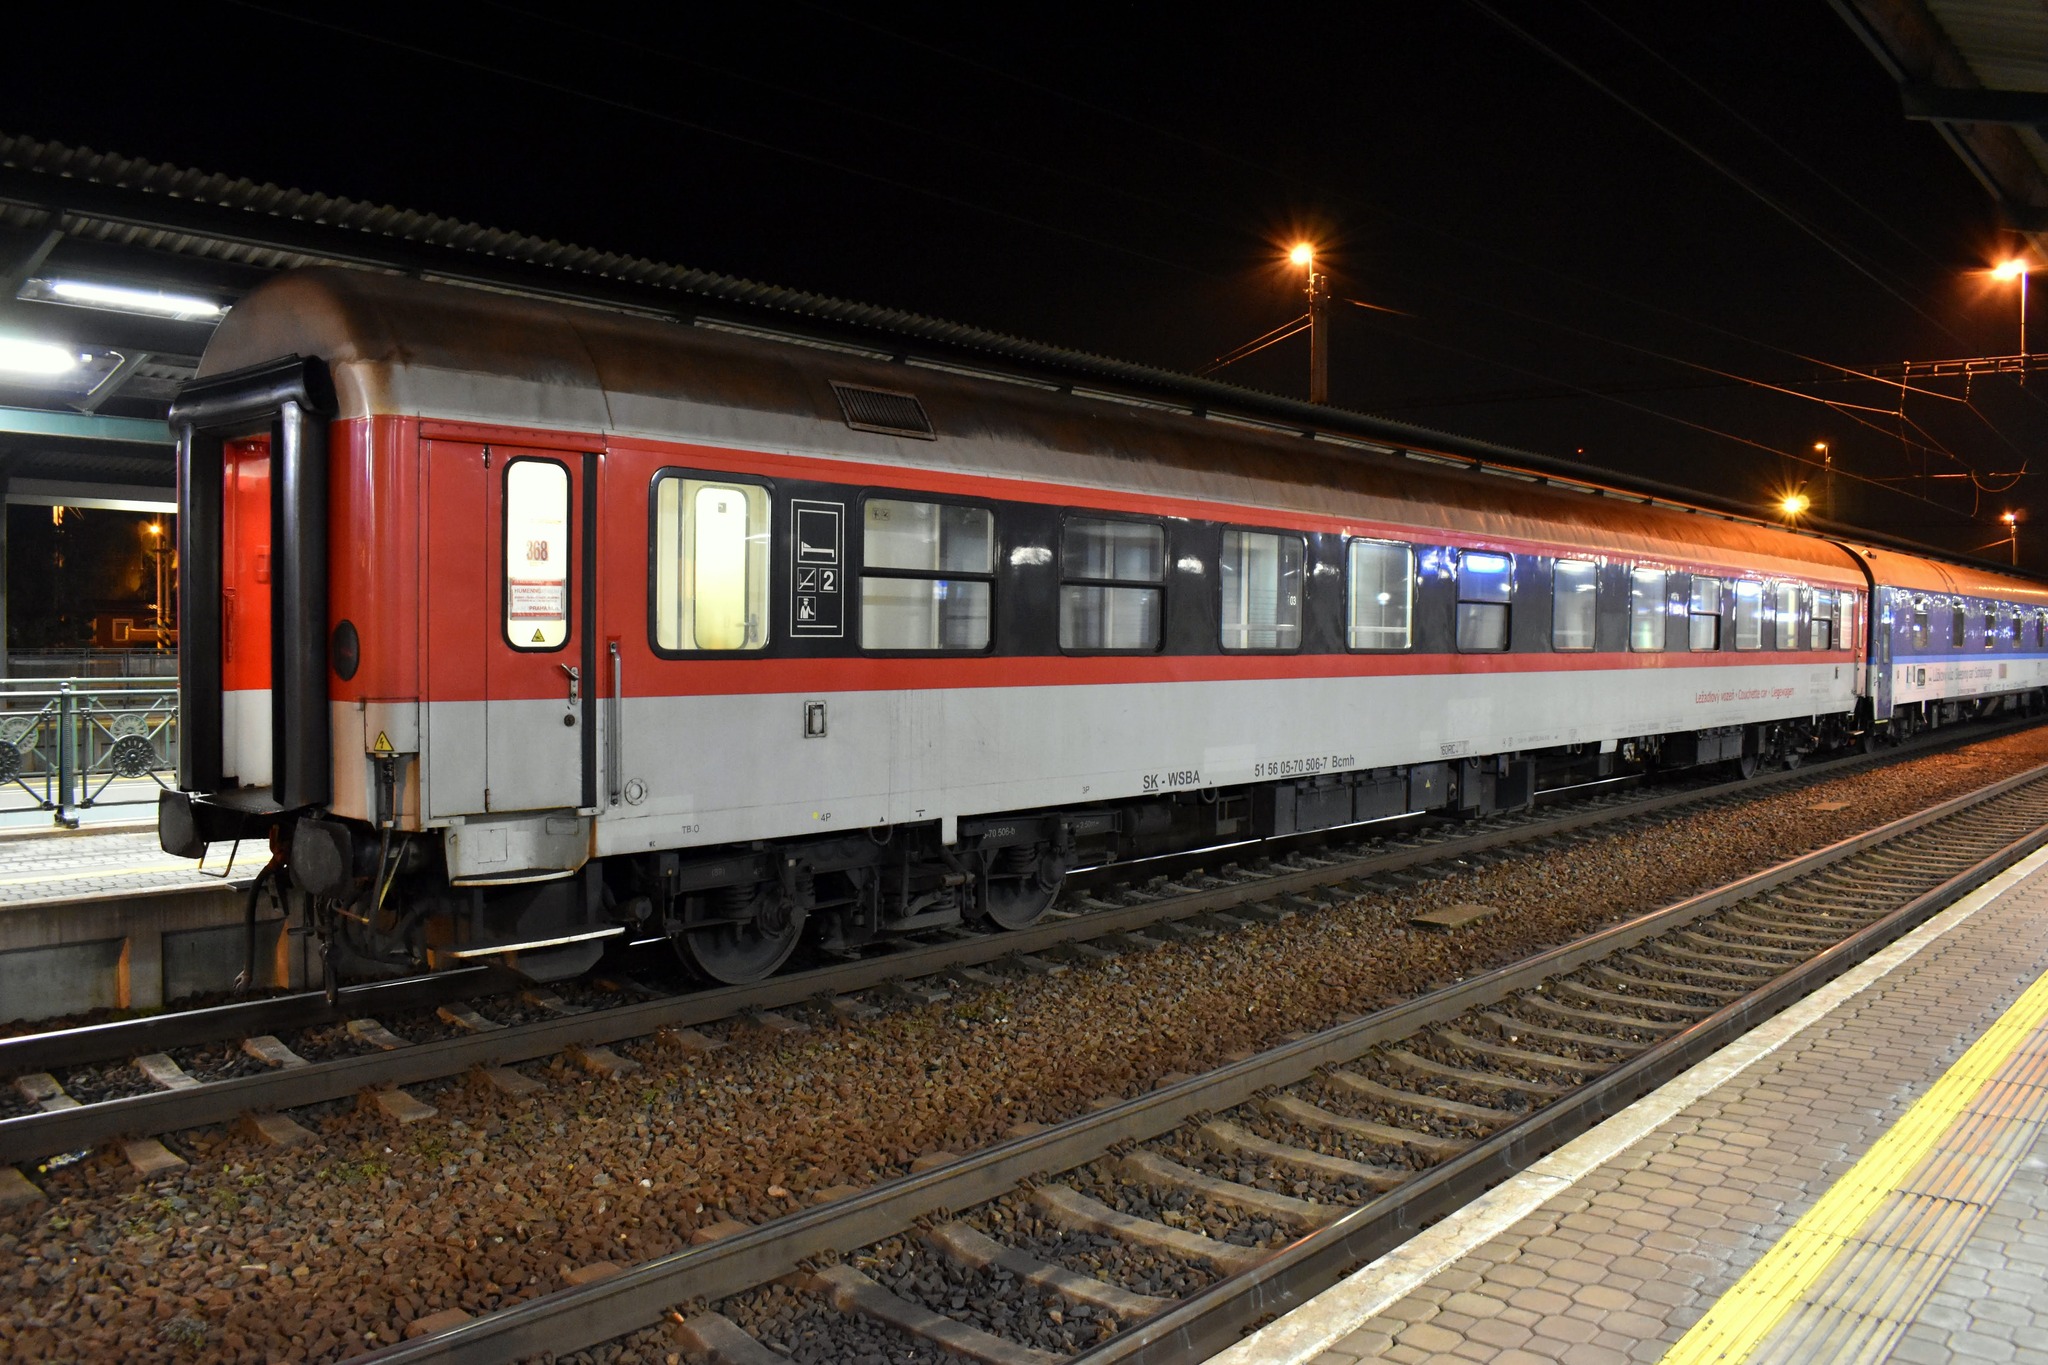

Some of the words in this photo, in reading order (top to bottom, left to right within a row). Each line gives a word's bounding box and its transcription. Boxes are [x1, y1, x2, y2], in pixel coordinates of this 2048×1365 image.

[527, 540, 548, 561] 368
[823, 571, 835, 590] 2
[1290, 595, 1297, 605] 03
[1255, 764, 1265, 777] 51
[1268, 761, 1278, 776] 56
[1280, 759, 1303, 774] 05-70
[1305, 757, 1327, 771] 506-7
[1332, 754, 1354, 768] Bcmh
[1143, 774, 1158, 789] SK
[1168, 770, 1200, 786] WSBA
[820, 812, 831, 822] 4P
